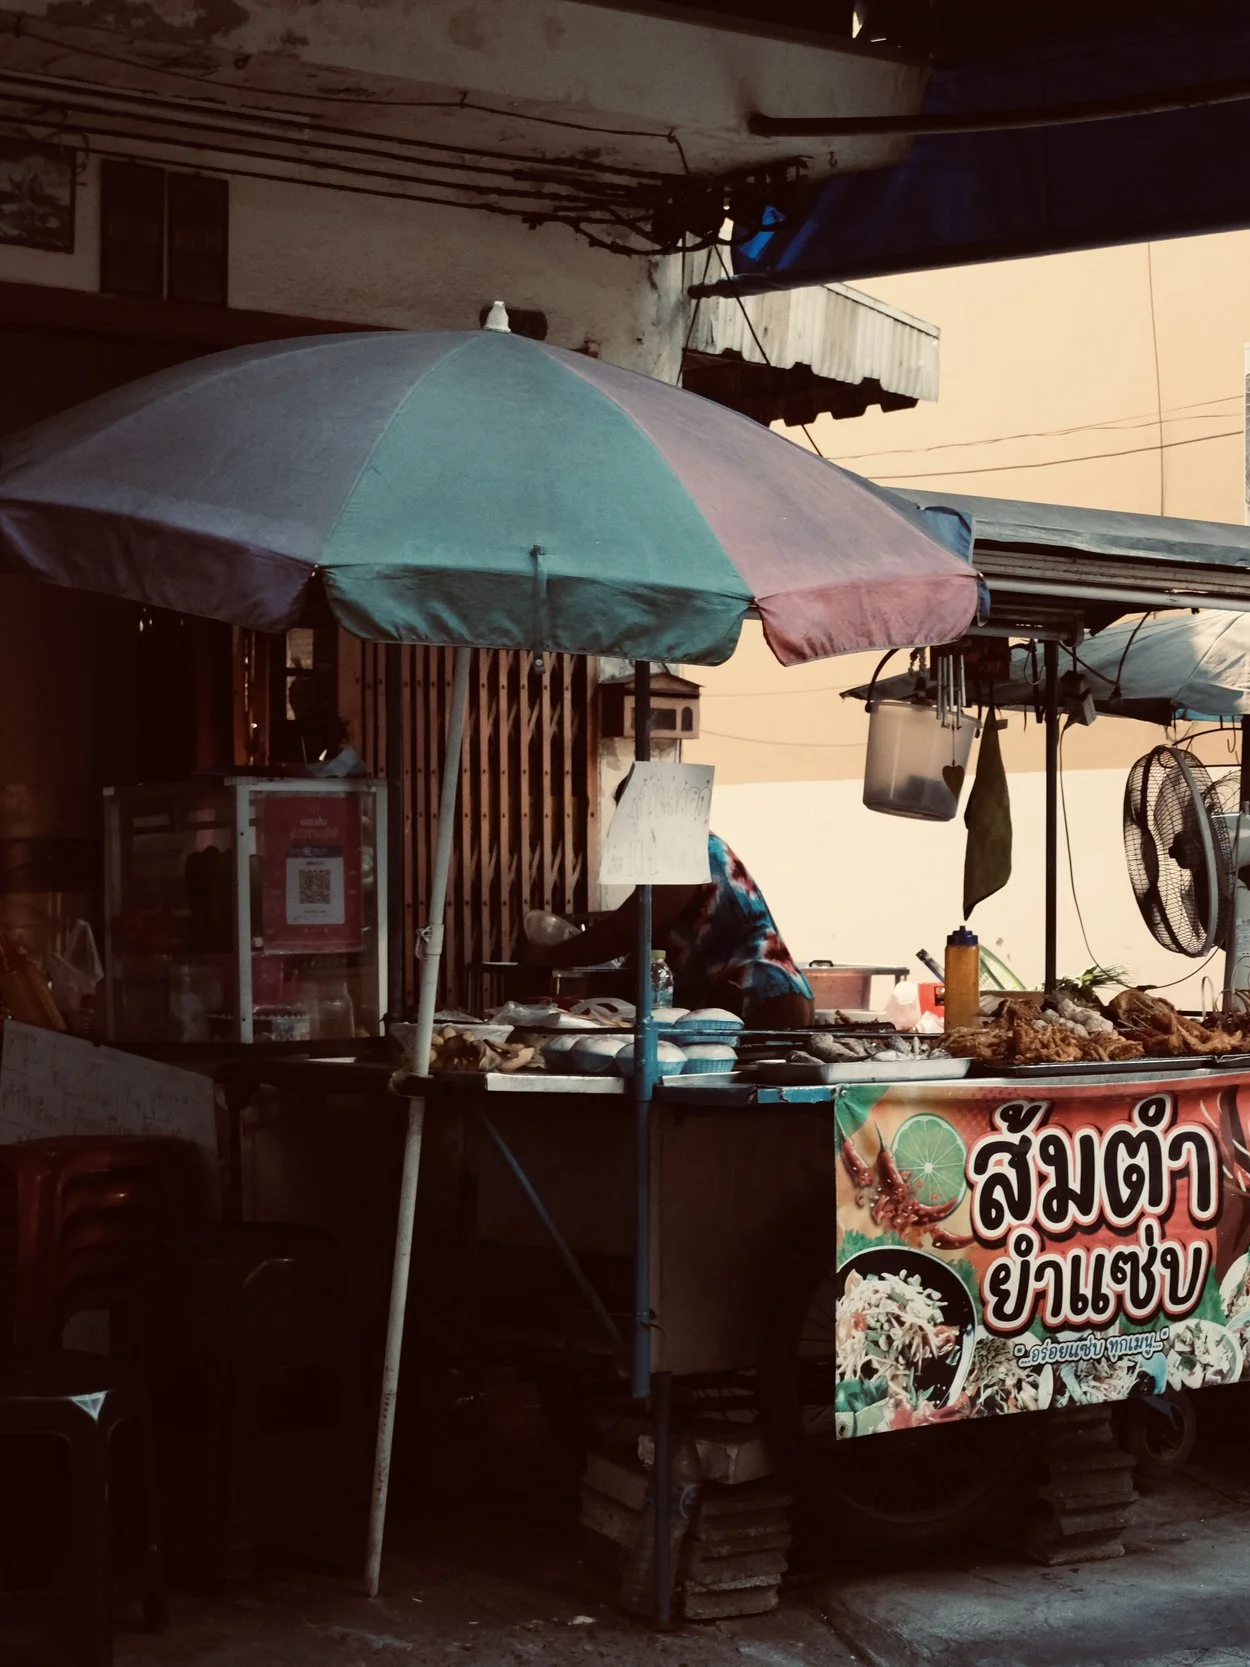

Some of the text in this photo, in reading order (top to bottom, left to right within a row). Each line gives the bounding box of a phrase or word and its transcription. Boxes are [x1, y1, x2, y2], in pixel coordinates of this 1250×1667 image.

[970, 1093, 1218, 1234] ส้มตำ
[982, 1219, 1209, 1329] ยำแซ่บ
